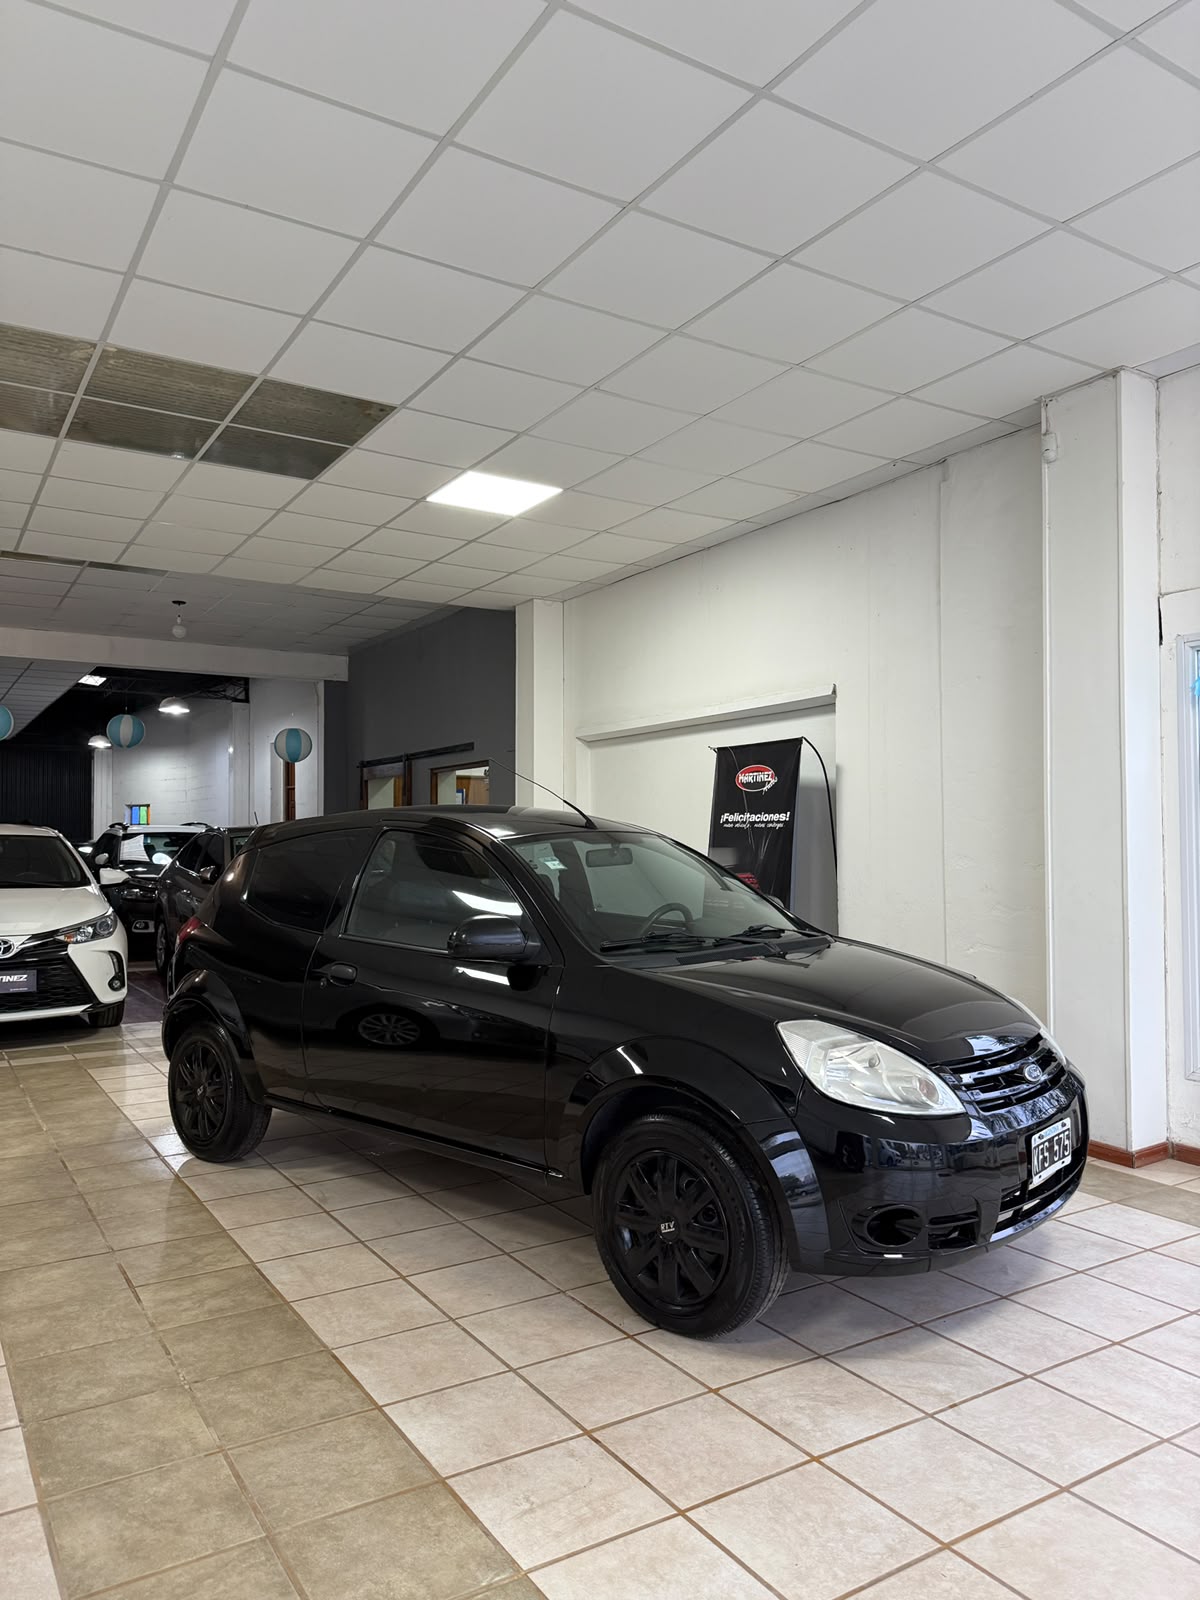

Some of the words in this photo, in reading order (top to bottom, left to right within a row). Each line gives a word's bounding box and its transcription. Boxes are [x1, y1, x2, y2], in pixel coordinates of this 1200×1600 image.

[738, 771, 773, 784] MARTINEZ
[720, 811, 791, 824] ¡Felicitaciones!
[1033, 1141, 1050, 1175] KFS
[1053, 1130, 1070, 1162] 575
[660, 1220, 675, 1231] RTV
